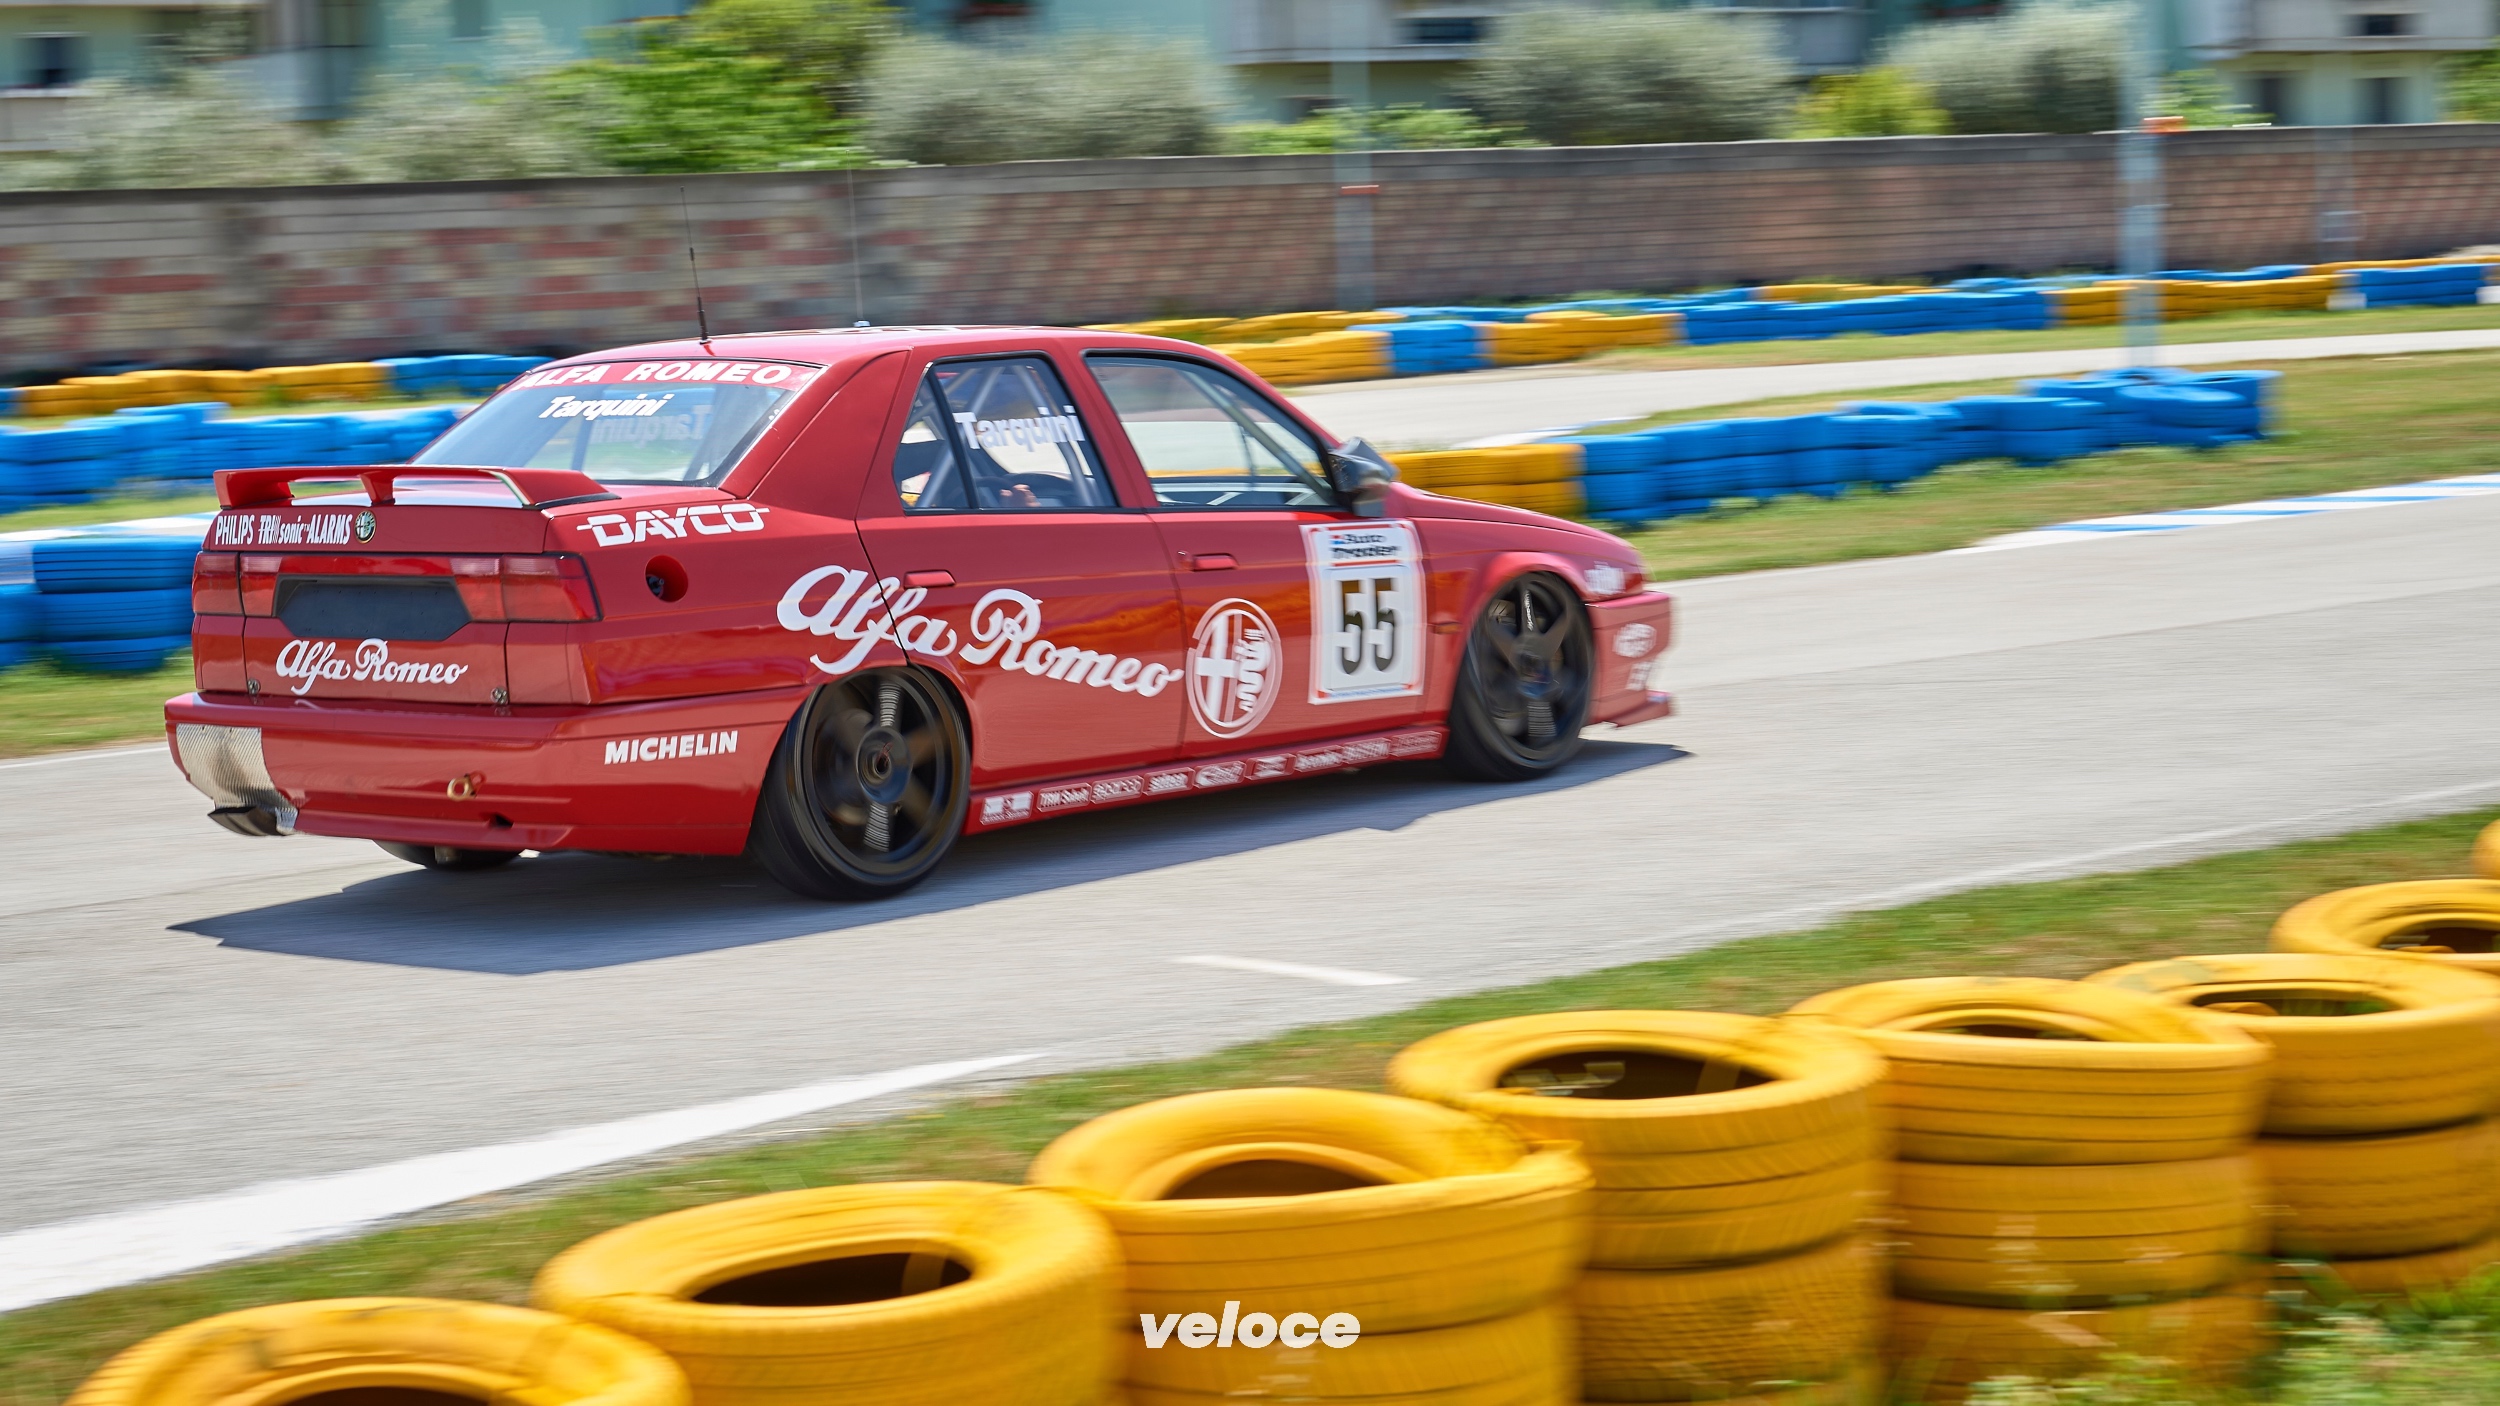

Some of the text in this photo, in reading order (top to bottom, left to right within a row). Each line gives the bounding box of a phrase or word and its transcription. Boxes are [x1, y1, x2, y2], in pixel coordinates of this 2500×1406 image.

[511, 361, 792, 391] ALFA ROMEO
[538, 394, 675, 420] Tarquini
[952, 405, 1086, 452] Tarquini
[215, 514, 255, 545] PHILIPS
[306, 513, 353, 545] ALARMS
[576, 503, 770, 547] DAYCO
[777, 564, 1184, 697] Alfa Romeo
[1339, 577, 1397, 675] 55
[275, 637, 469, 695] Alfa Romeo
[604, 730, 738, 765] MICHELIN
